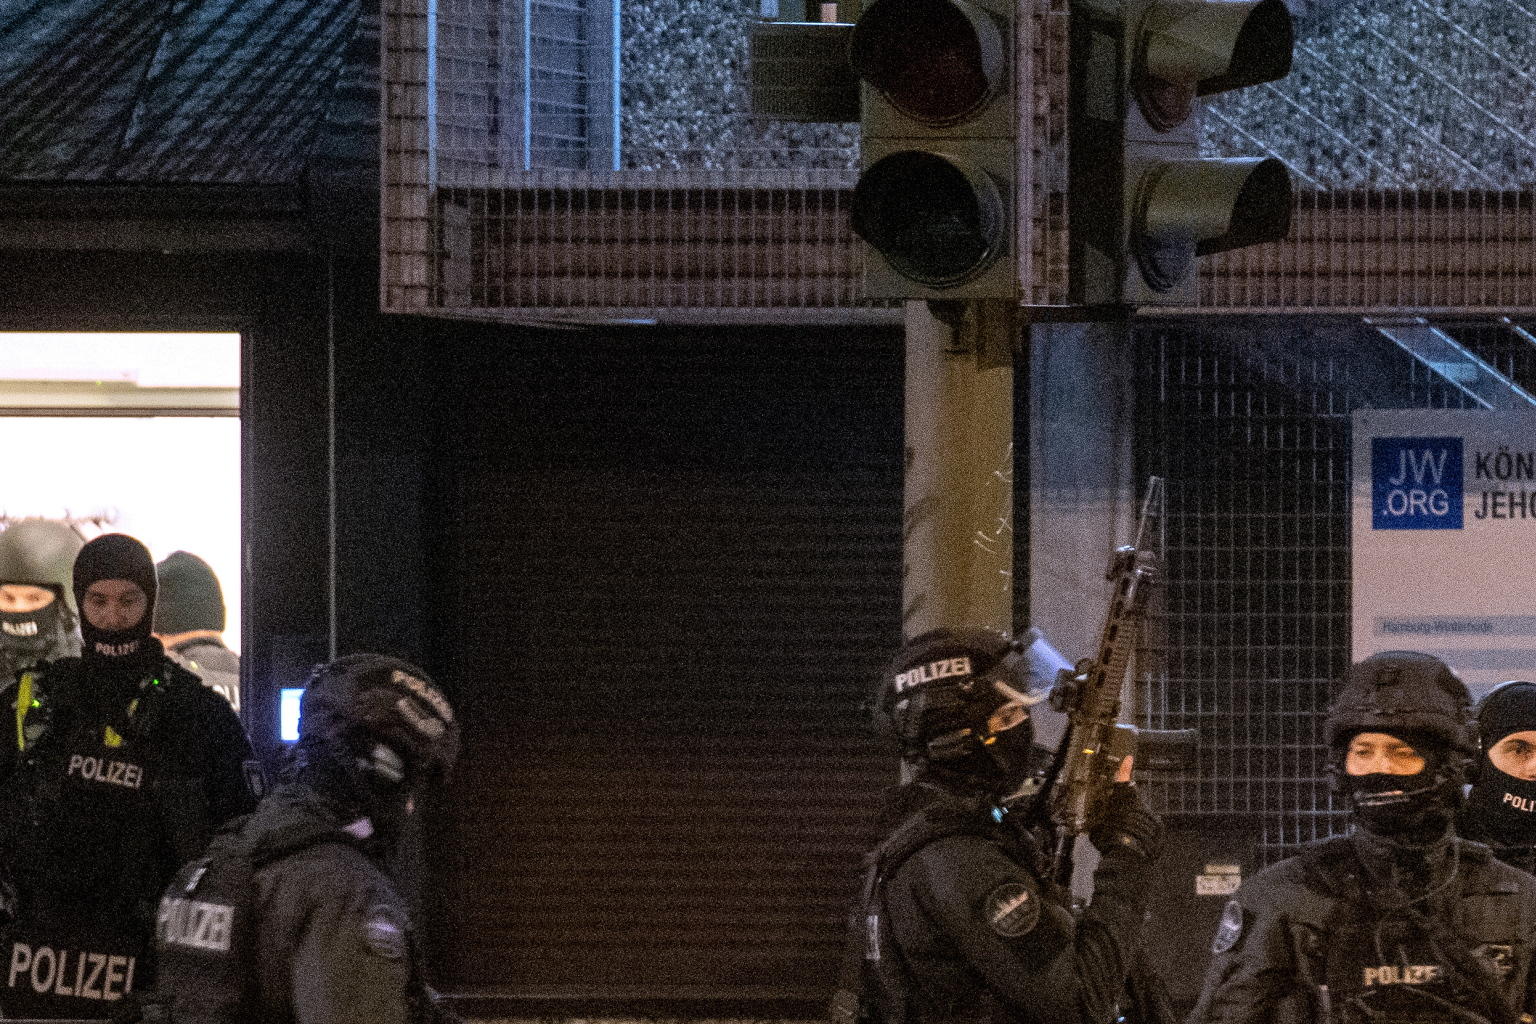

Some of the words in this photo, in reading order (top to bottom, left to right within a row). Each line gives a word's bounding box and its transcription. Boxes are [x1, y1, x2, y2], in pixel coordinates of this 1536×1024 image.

[1388, 449, 1448, 485] JW
[1381, 489, 1450, 517] .ORG
[895, 657, 971, 693] POLIZEI
[67, 754, 143, 790] POLIZEI
[8, 942, 136, 1001] POLIZEI
